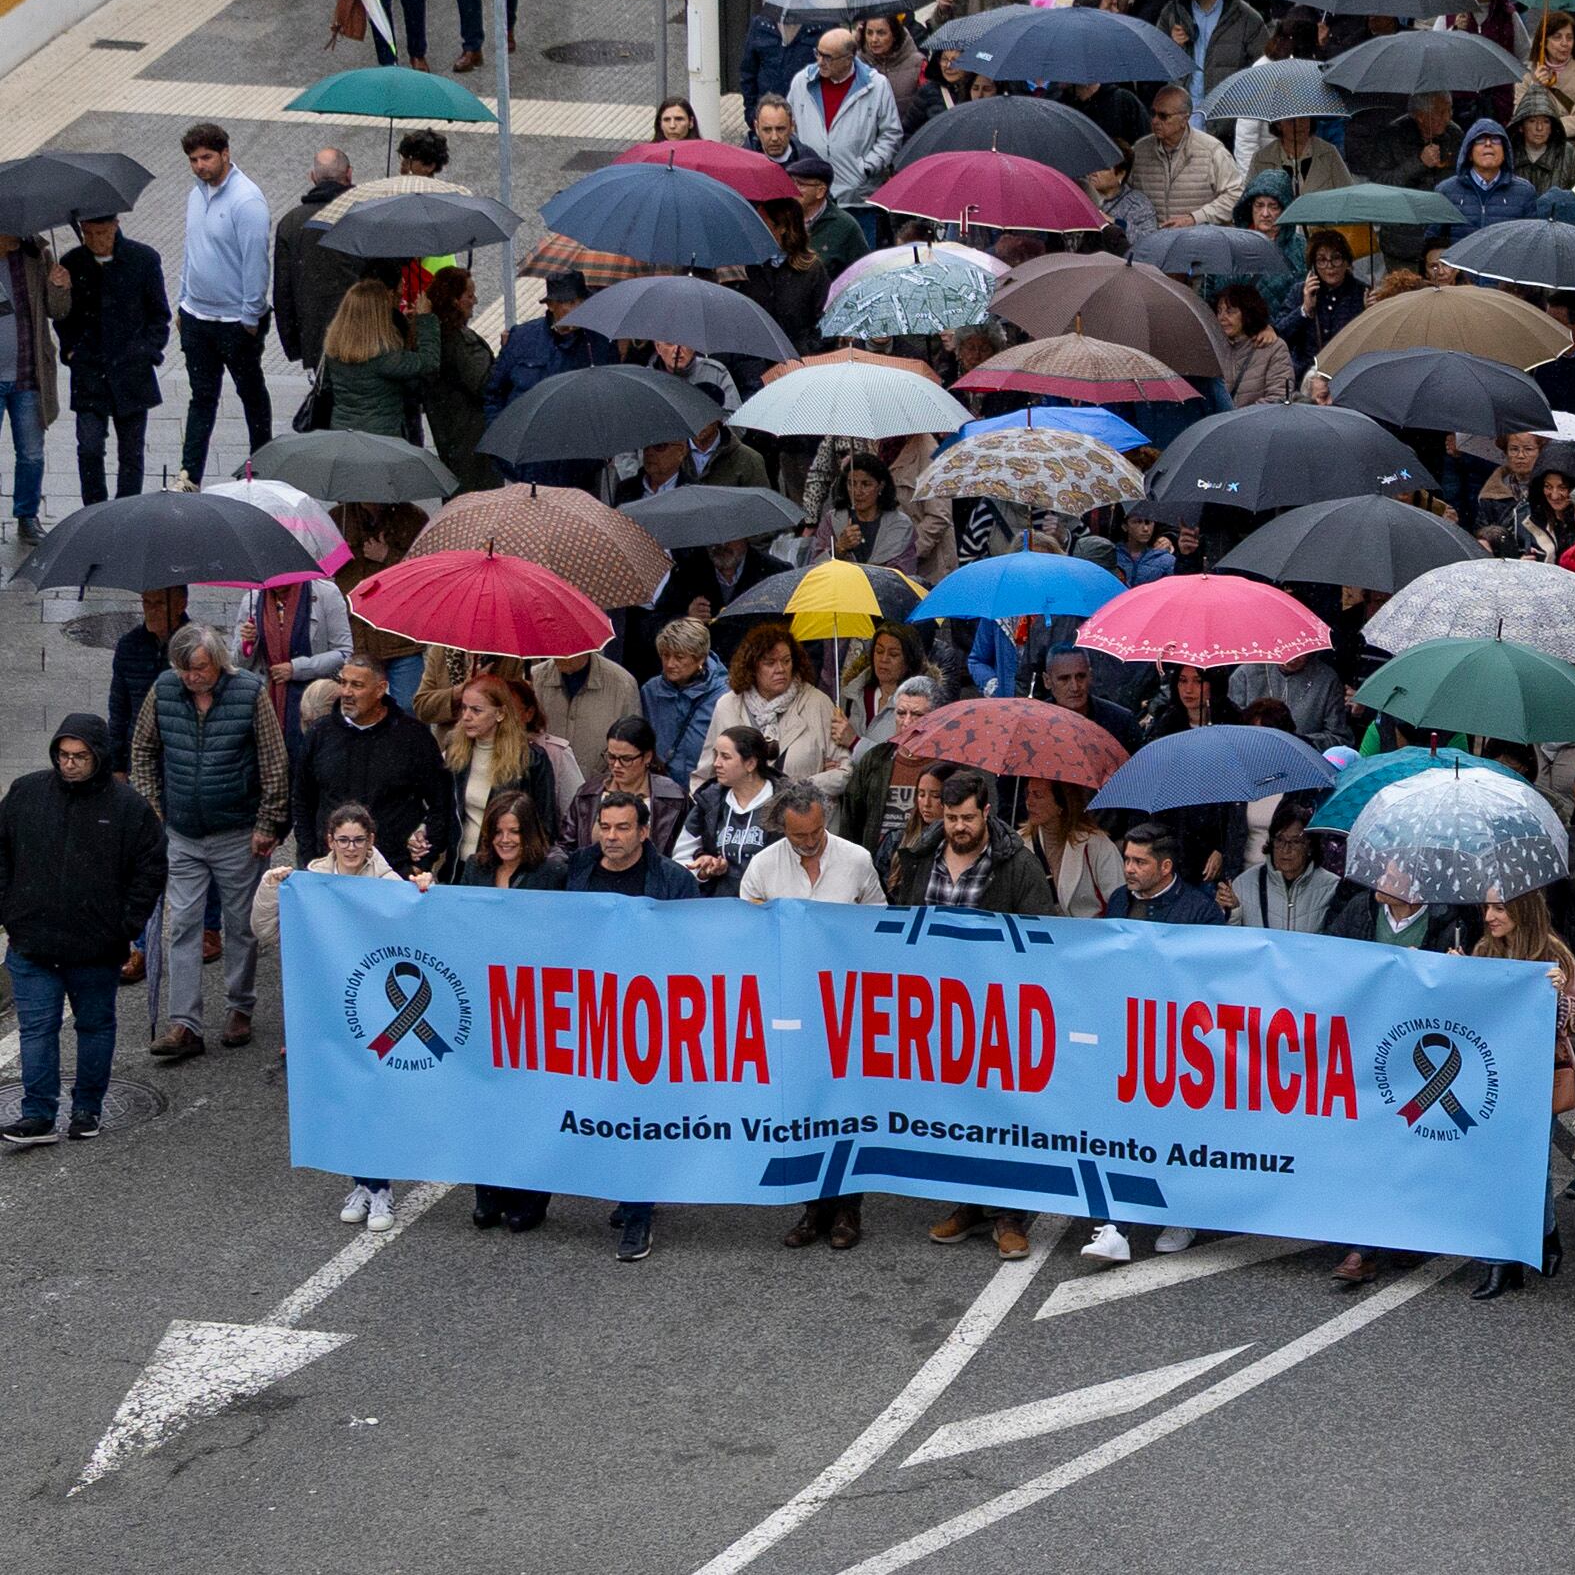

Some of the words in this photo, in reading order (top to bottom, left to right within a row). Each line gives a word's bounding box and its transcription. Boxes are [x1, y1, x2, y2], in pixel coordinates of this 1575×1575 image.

[344, 968, 366, 1040] ASOCIACIÓN
[359, 945, 412, 972] VÍCTIMAS
[413, 947, 473, 1047] DESCARRILAMIENTO
[385, 1054, 437, 1072] ADAMUZ
[487, 965, 771, 1085] MEMORIA
[818, 970, 1056, 1093] VERDAD
[1117, 996, 1359, 1120] JUSTICIA
[1372, 1037, 1397, 1106] ASOCIACIÓN
[1388, 1017, 1440, 1042] VÍCTIMAS
[1443, 1018, 1499, 1120] DESCARRILAMIENTO
[559, 1109, 732, 1142] Asociación
[742, 1114, 878, 1144] Víctimas
[888, 1110, 1157, 1163] Descarrilamiento
[1166, 1141, 1295, 1174] Adamuz
[1413, 1123, 1462, 1142] ADAMUZ
